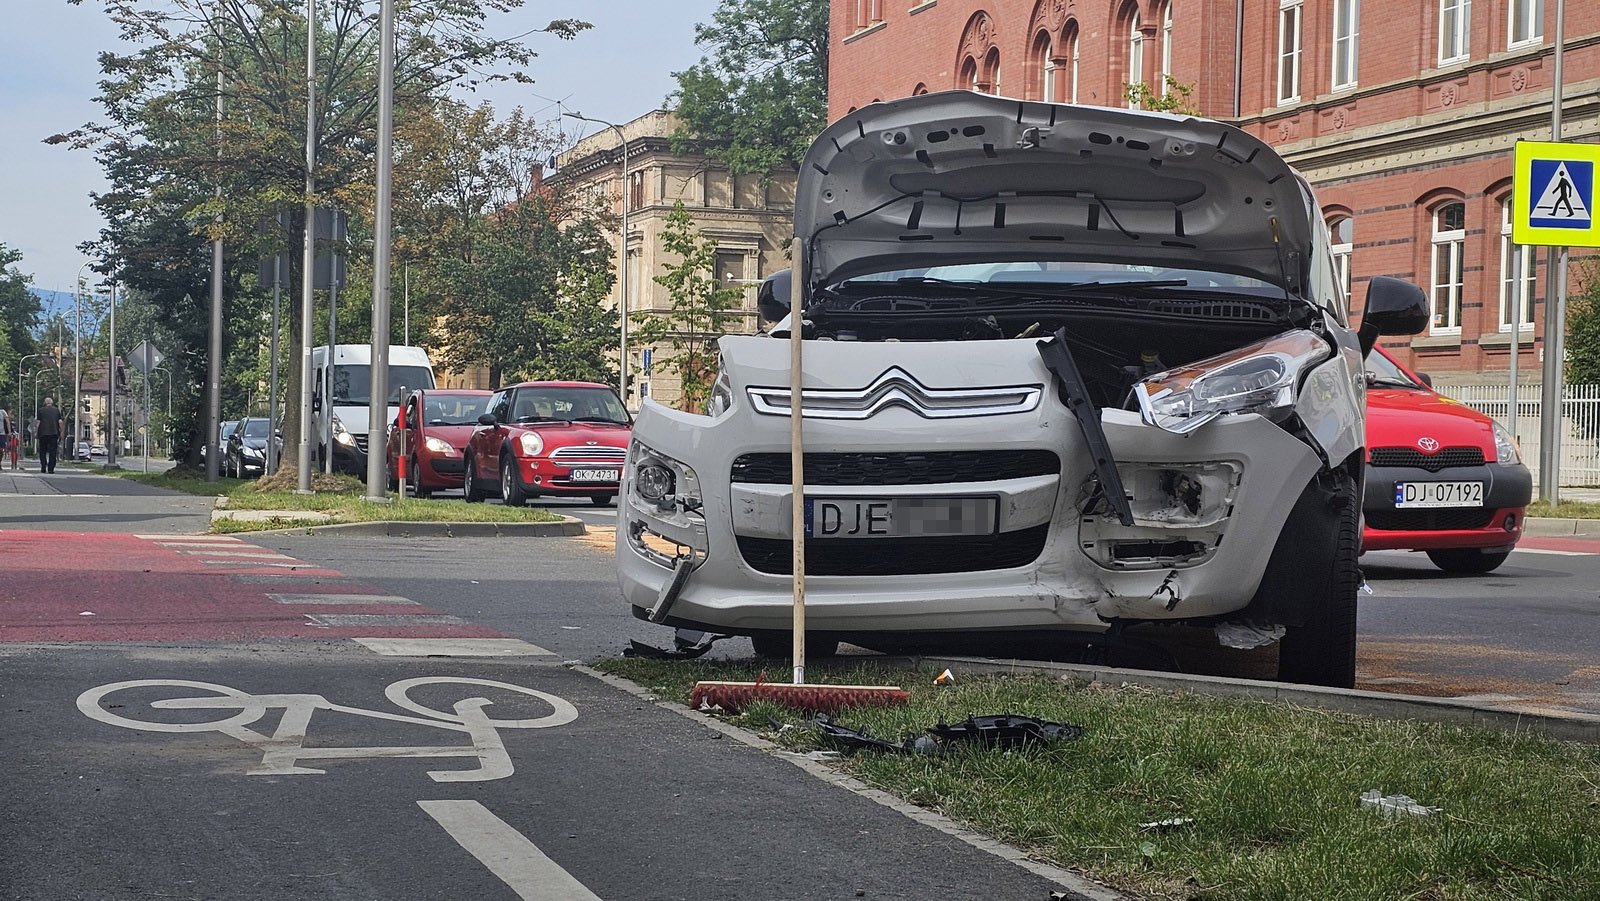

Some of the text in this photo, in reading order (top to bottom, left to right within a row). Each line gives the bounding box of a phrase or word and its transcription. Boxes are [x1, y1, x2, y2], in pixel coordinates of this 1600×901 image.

[575, 470, 588, 479] OK
[590, 470, 616, 479] 74731
[1405, 483, 1481, 502] DJ 07192
[821, 503, 888, 535] DJE
